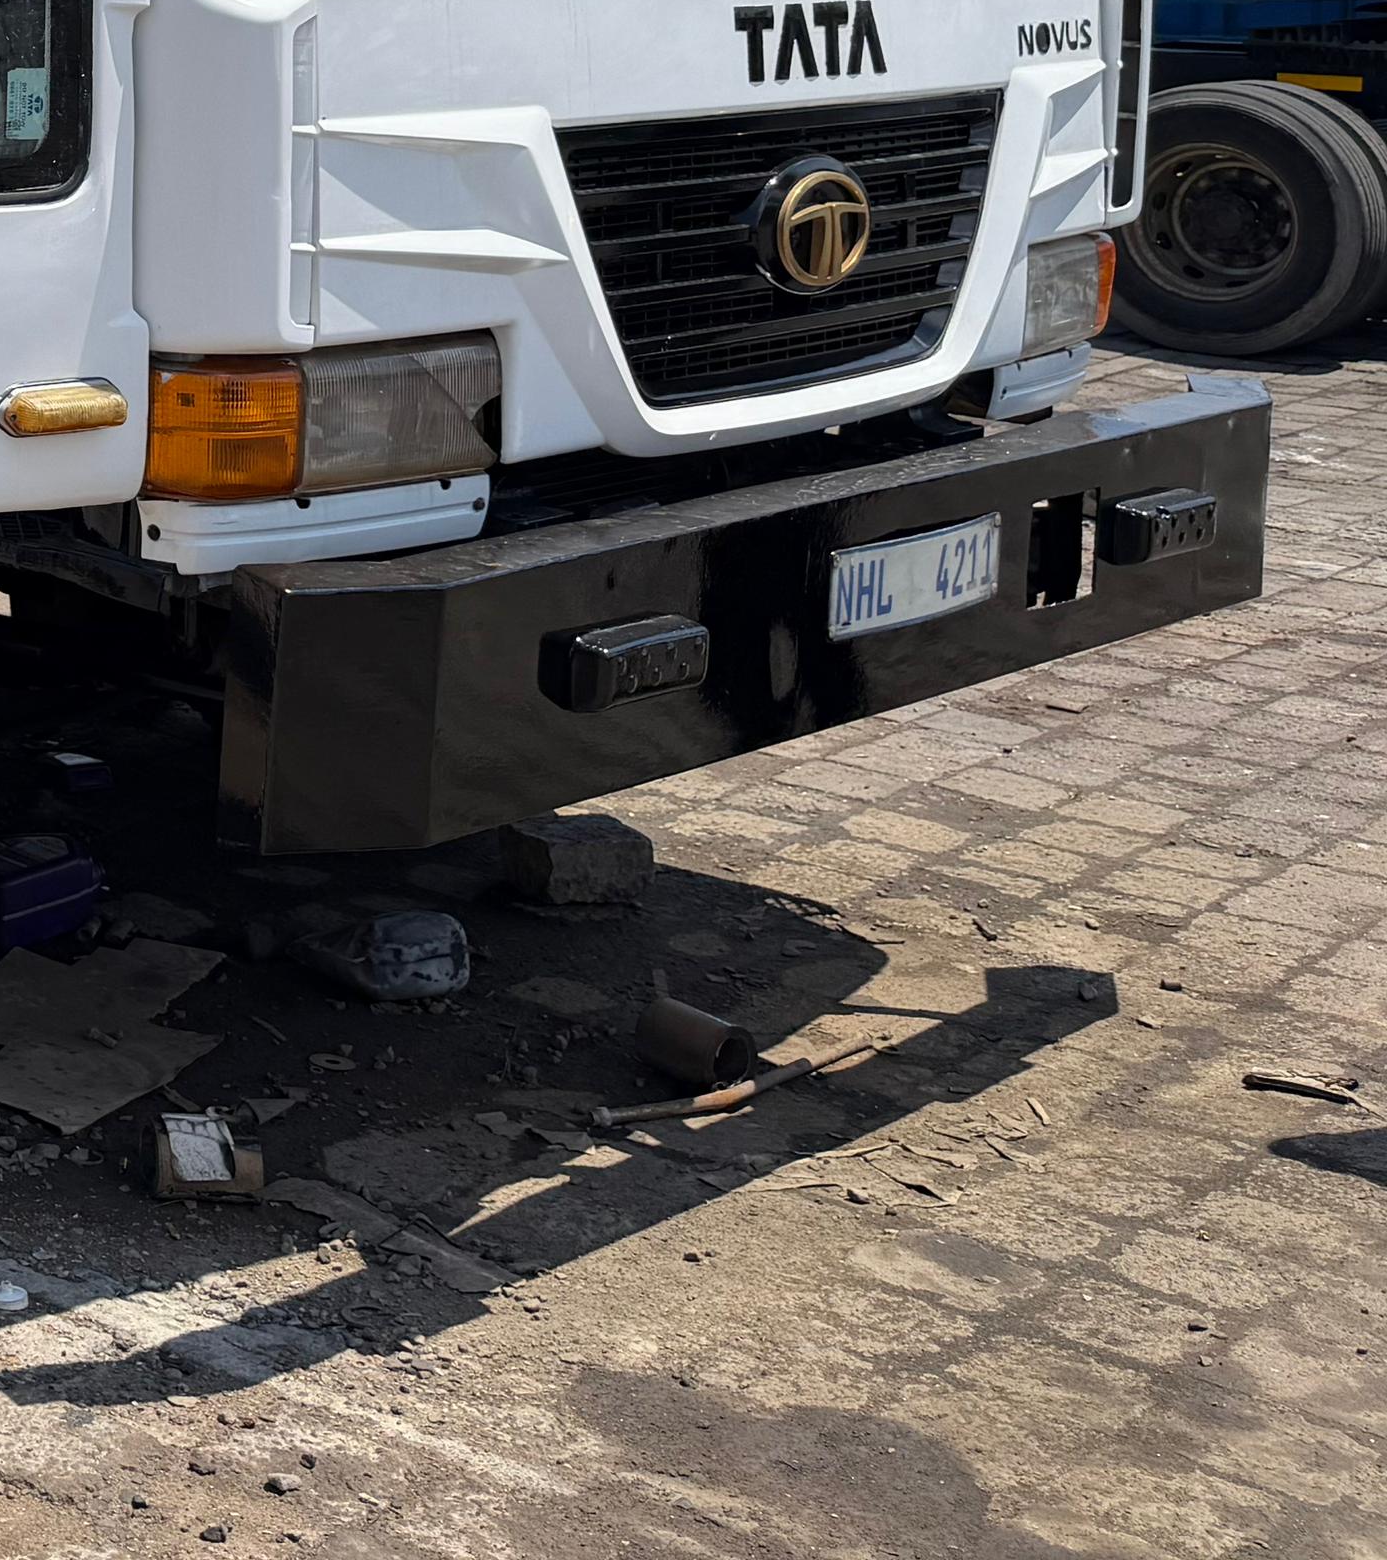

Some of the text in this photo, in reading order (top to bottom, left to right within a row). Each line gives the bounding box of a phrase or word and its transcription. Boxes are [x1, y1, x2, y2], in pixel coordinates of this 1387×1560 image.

[733, 0, 888, 82] TATA
[1017, 19, 1092, 56] NOVUS
[835, 528, 992, 625] NHL 4211
